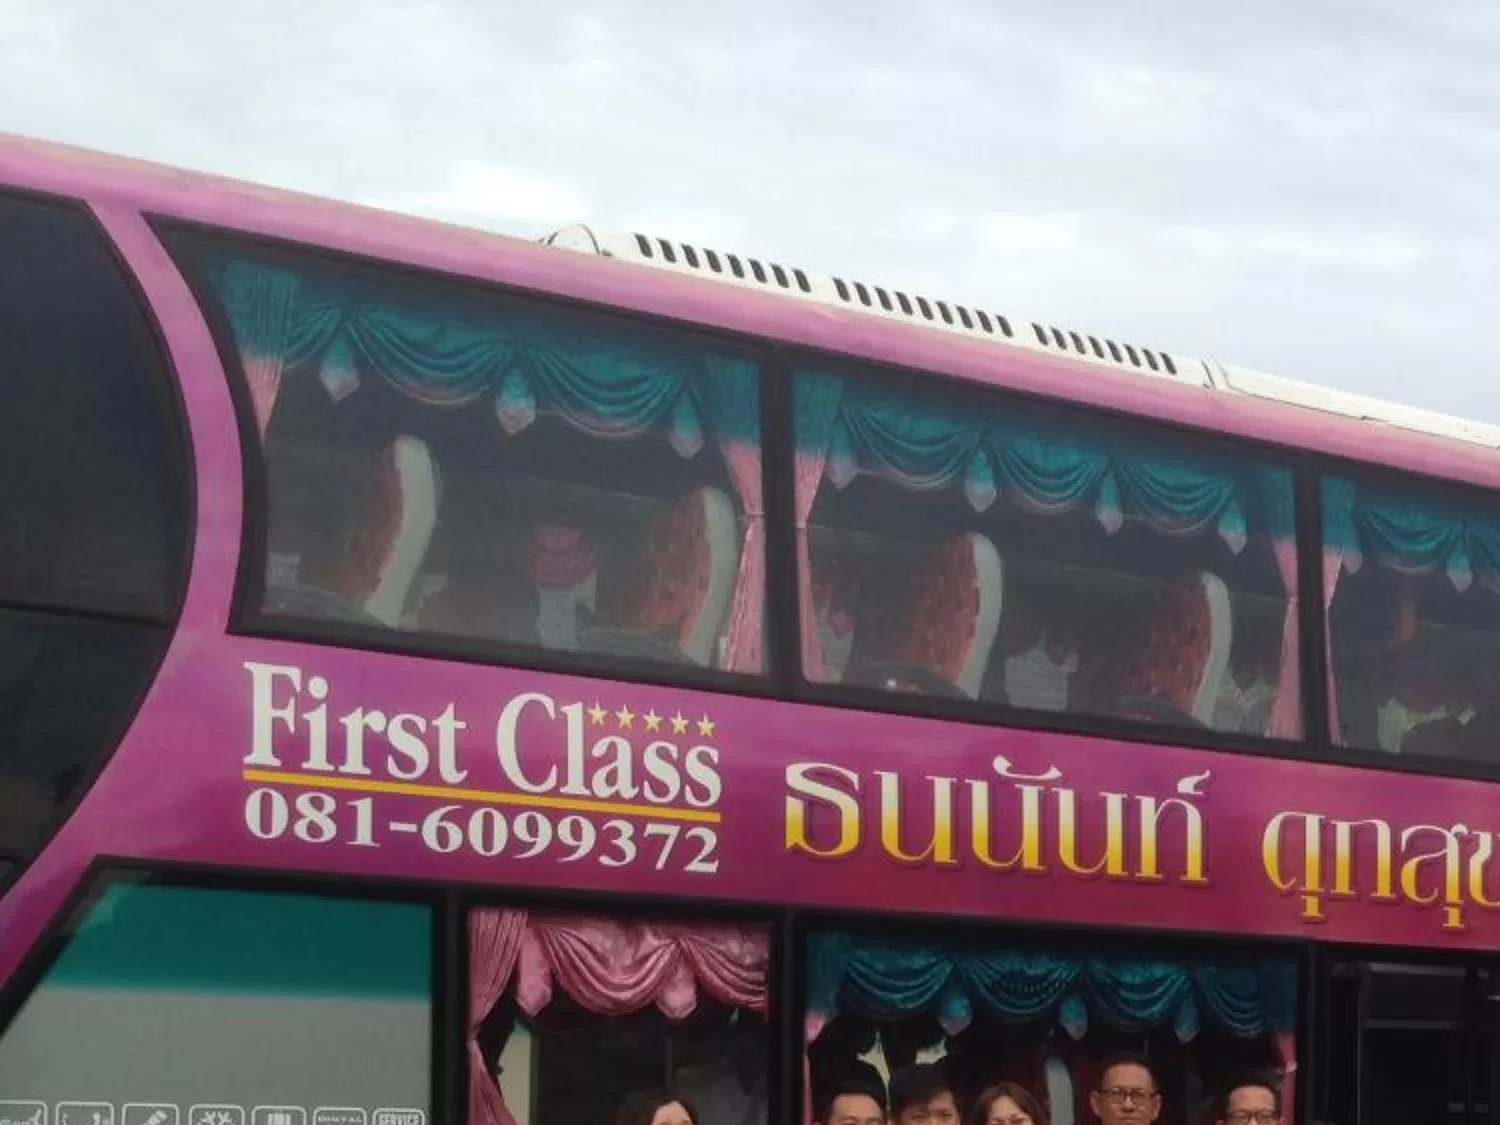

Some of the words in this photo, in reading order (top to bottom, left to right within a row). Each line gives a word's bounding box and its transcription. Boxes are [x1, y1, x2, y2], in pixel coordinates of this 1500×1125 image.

[243, 661, 468, 785] First
[496, 692, 722, 807] Class
[243, 787, 720, 874] 081-6099372
[785, 755, 1211, 882] ธนนันท์
